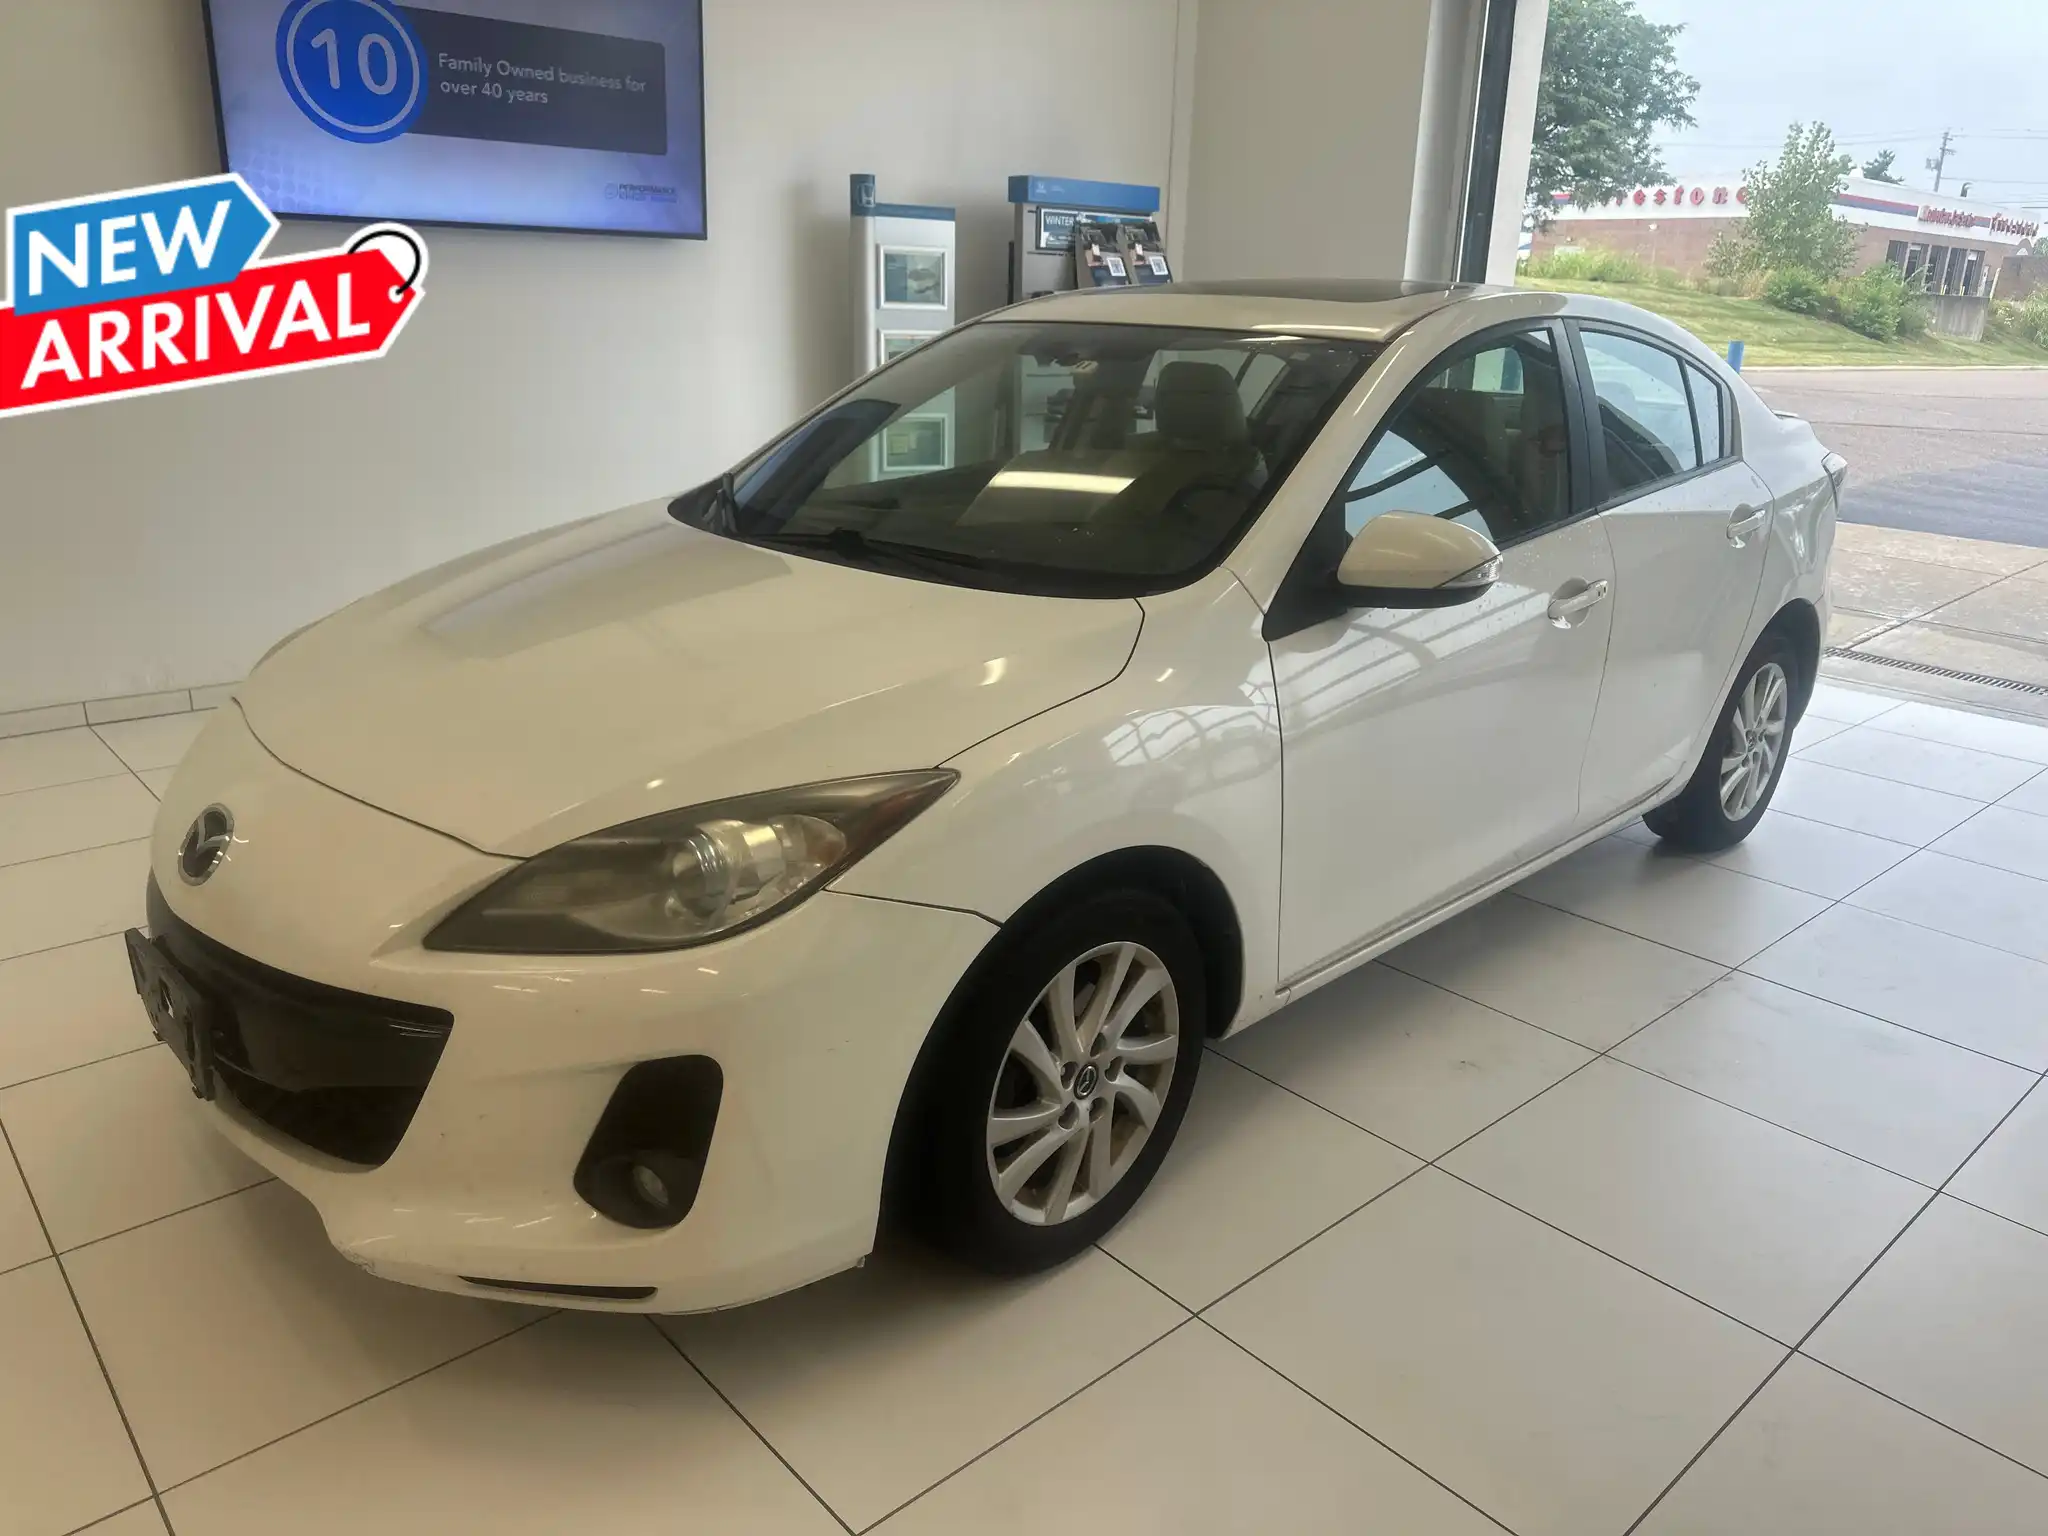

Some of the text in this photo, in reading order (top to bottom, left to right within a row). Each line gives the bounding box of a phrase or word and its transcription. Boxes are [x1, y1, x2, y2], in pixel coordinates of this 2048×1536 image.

[310, 28, 398, 95] 10
[438, 53, 646, 92] Family Owned business for
[440, 80, 548, 104] over 40 years
[1045, 215, 1074, 226] WINTER
